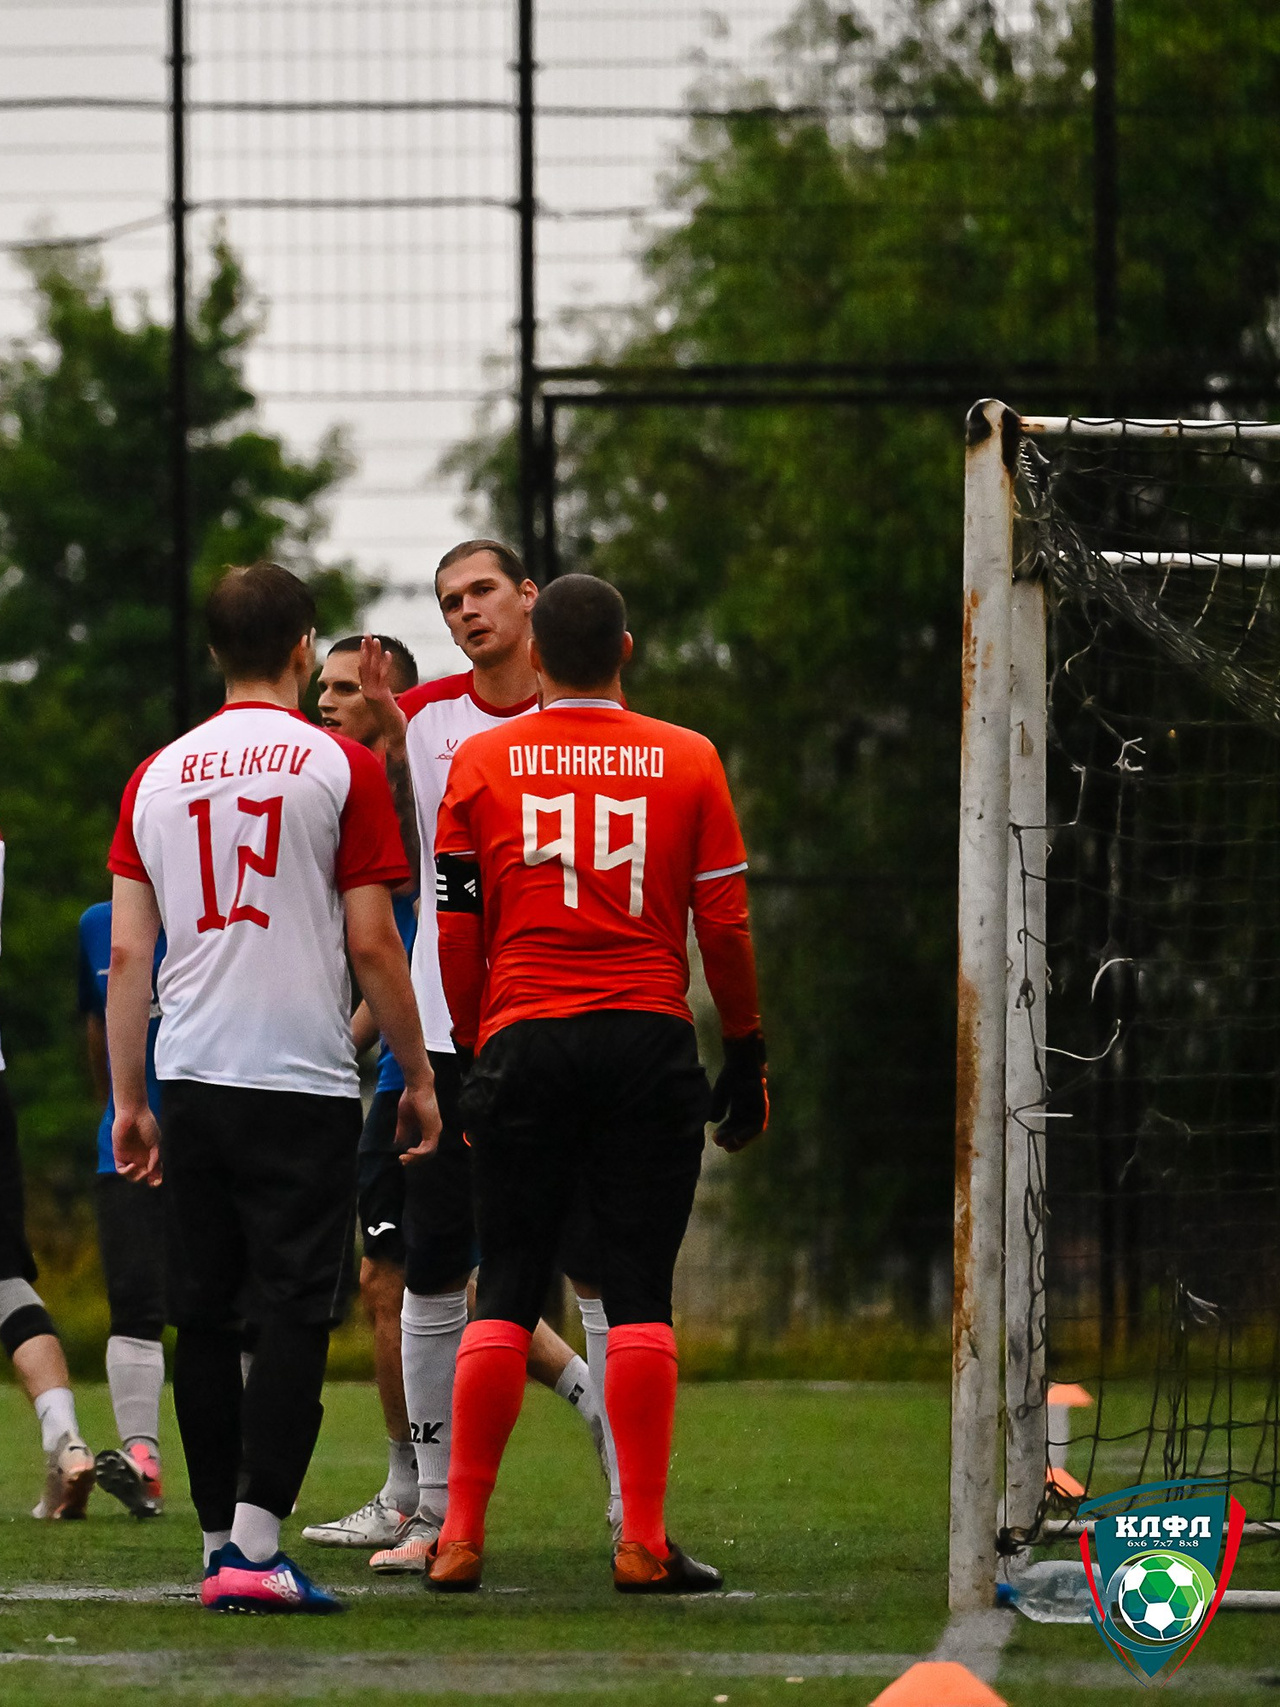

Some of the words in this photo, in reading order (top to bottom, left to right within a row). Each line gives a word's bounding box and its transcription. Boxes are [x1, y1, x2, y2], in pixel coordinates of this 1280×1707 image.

[181, 744, 312, 784] BELIKOV
[508, 745, 664, 779] OVCHARENKO
[188, 795, 283, 934] 12
[522, 792, 647, 918] 99
